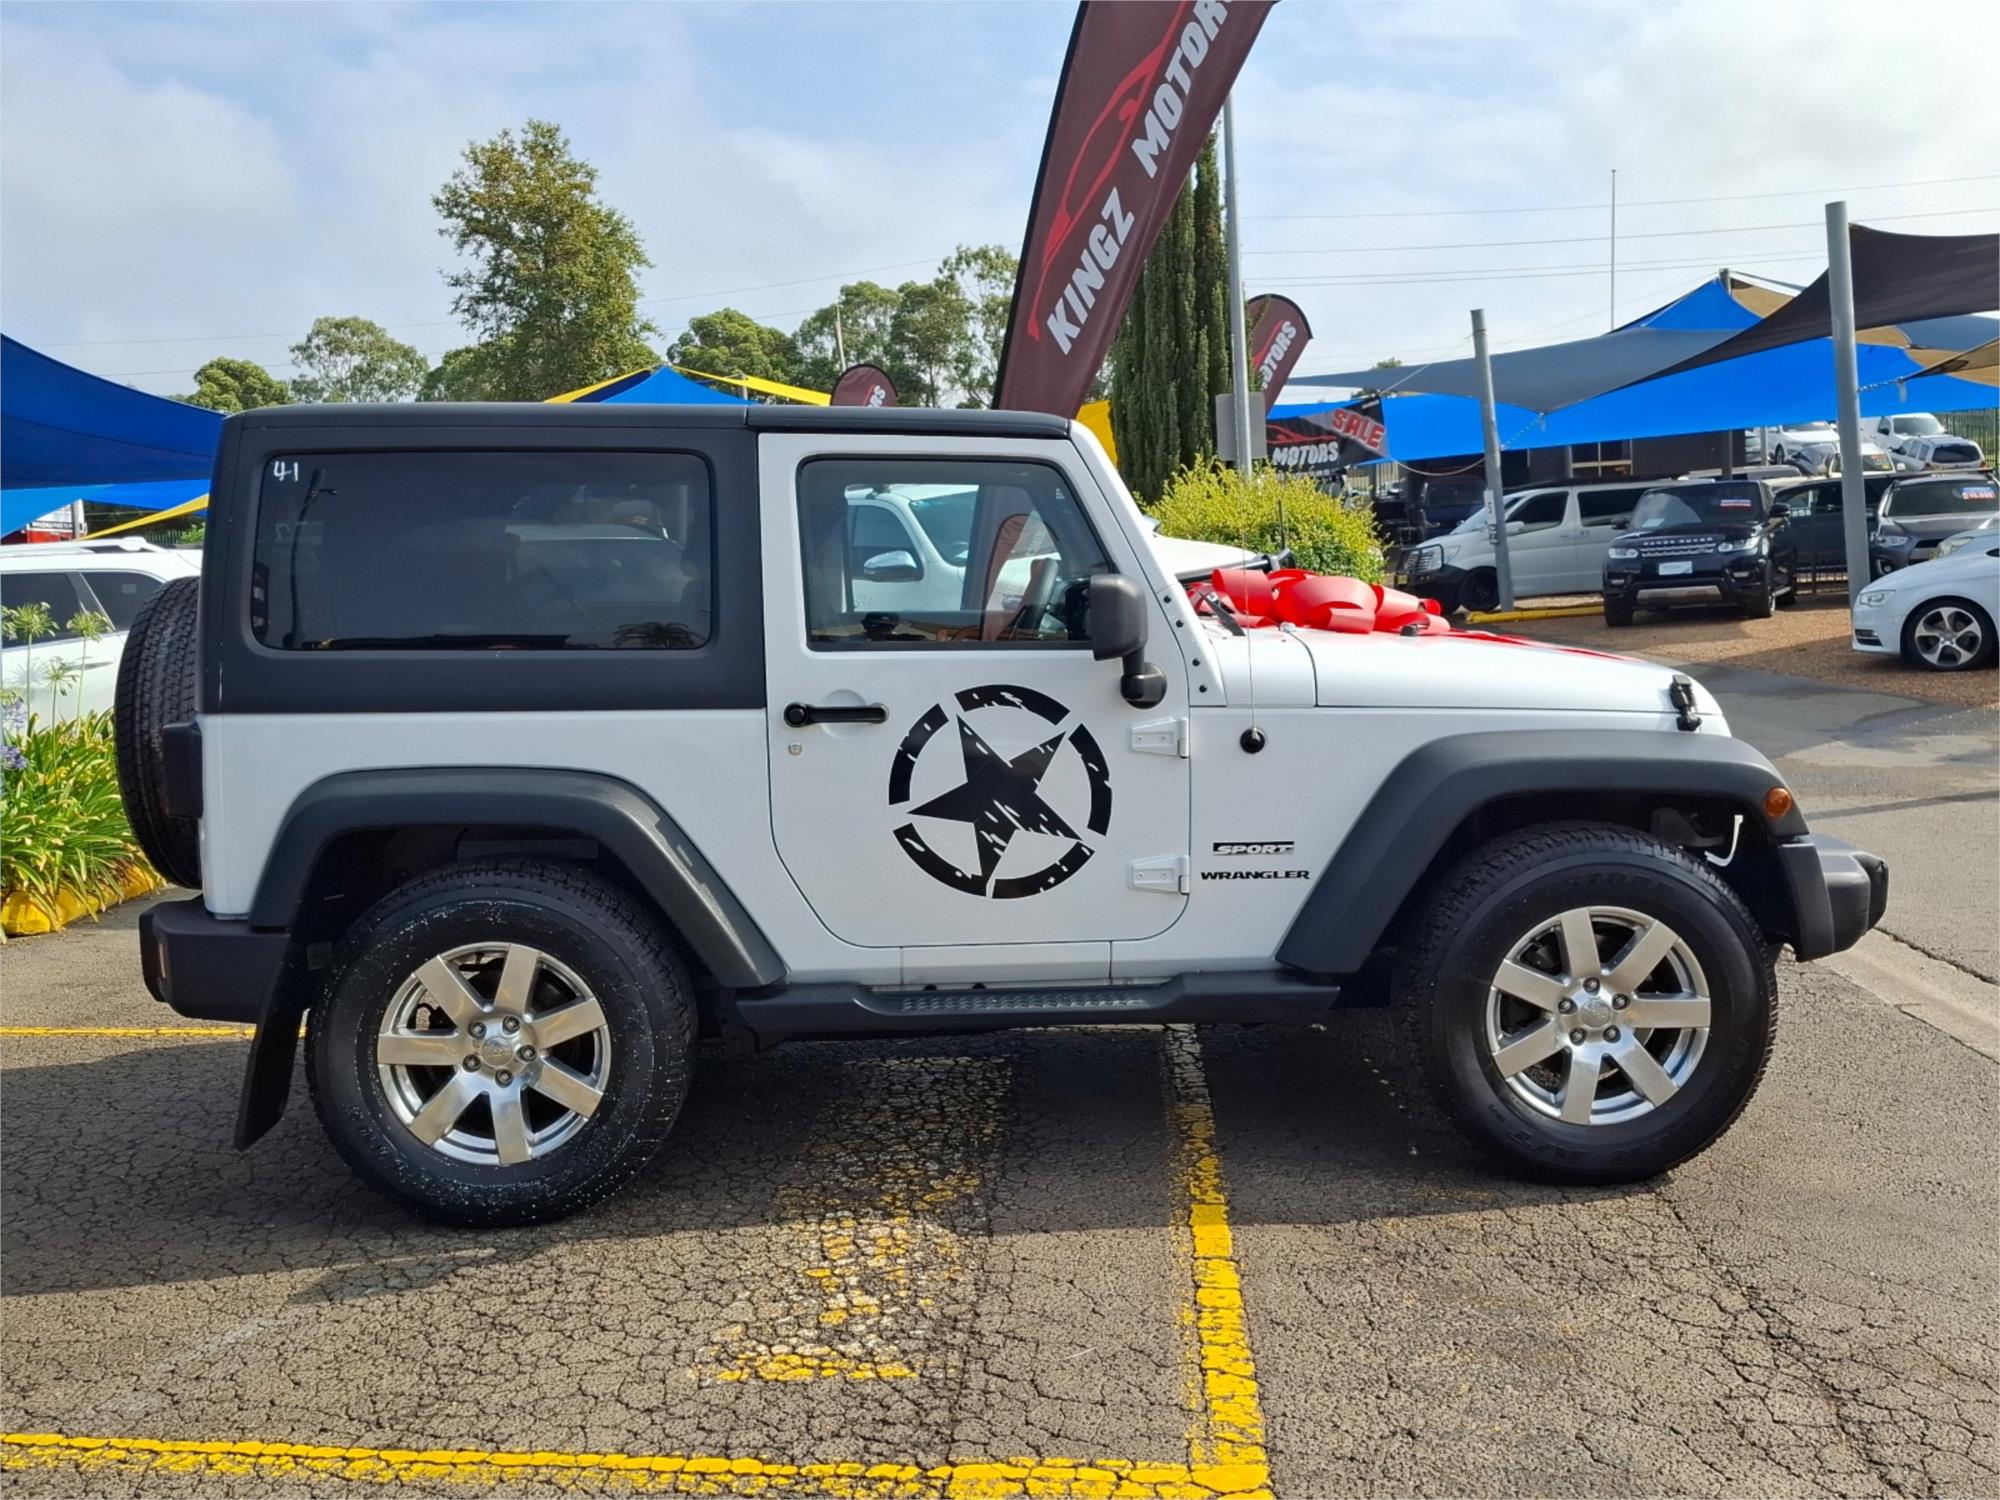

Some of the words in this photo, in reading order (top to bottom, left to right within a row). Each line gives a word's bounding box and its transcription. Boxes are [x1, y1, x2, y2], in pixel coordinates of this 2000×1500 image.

[1047, 187, 1136, 355] KINGZ
[1131, 0, 1232, 178] MOTOR
[1259, 320, 1297, 390] OTORS
[1331, 407, 1387, 449] SALE
[1272, 442, 1338, 465] MOTORS
[273, 461, 299, 482] 41
[1213, 841, 1295, 855] SPORT
[1200, 870, 1310, 880] WRANGLER
